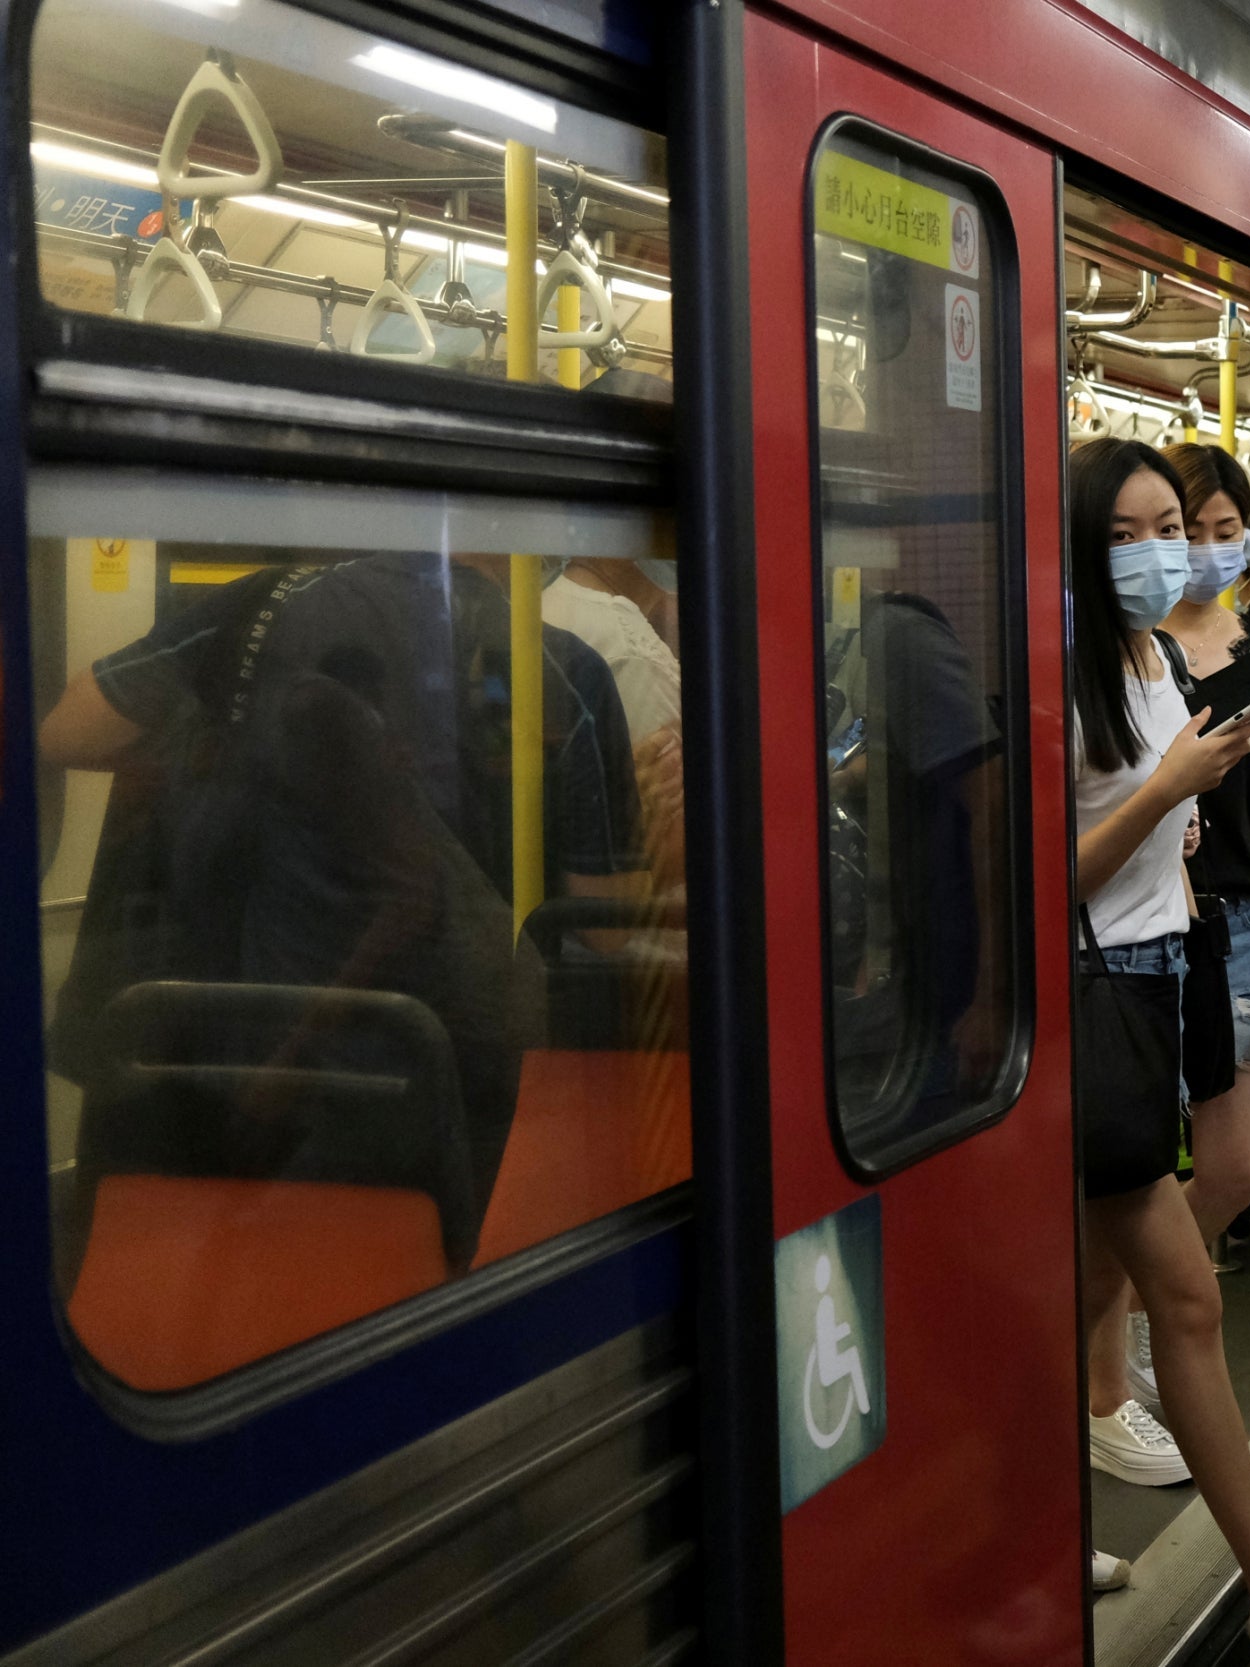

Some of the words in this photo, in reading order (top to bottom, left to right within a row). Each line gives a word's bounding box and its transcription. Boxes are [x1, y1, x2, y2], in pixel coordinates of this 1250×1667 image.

[825, 174, 941, 247] 請小心月台空隙
